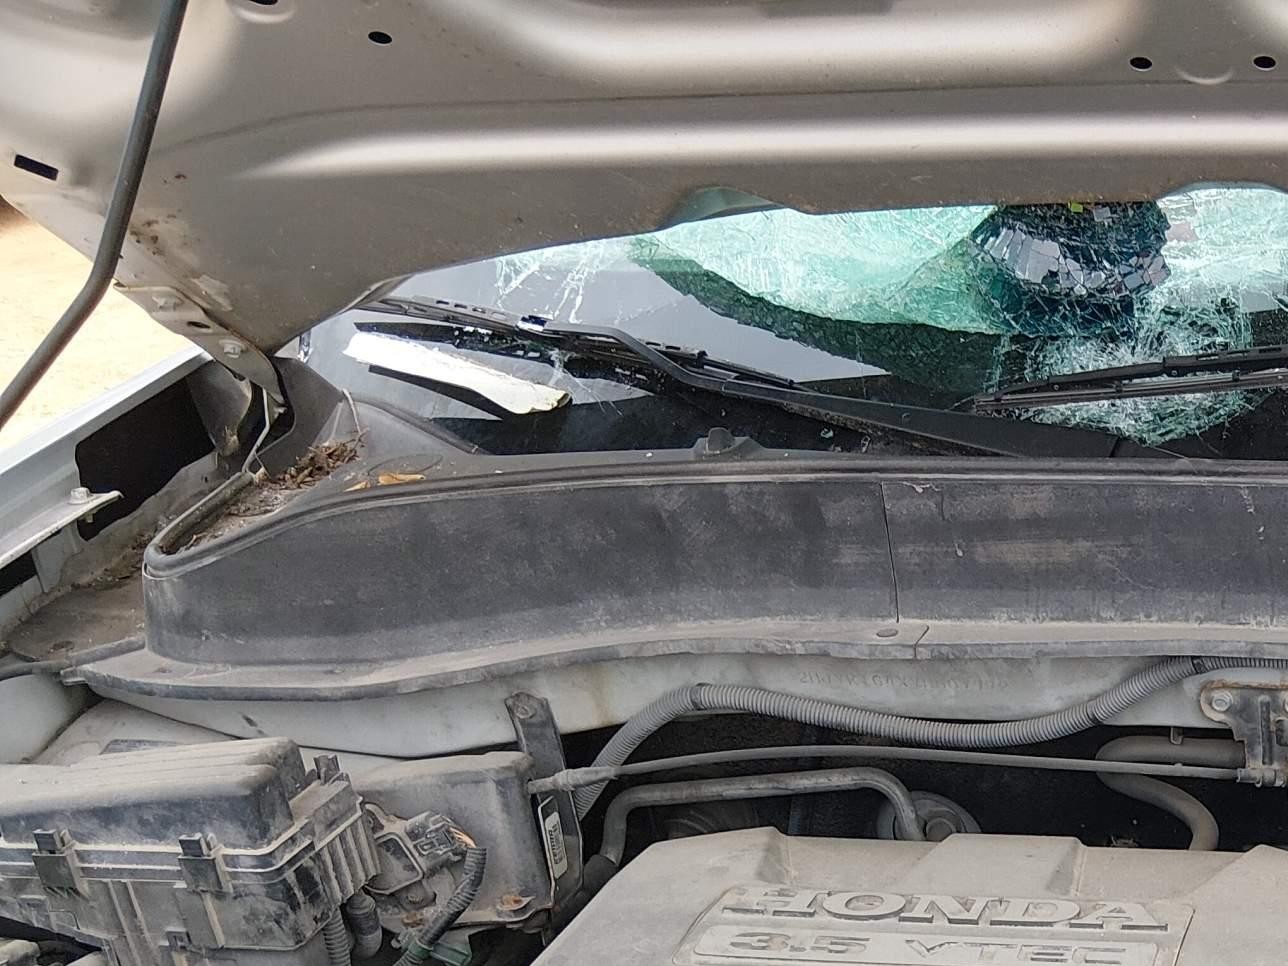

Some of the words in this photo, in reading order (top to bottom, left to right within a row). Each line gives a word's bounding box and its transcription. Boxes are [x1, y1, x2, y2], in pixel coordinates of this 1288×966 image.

[722, 889, 1169, 931] HONDA
[729, 932, 871, 954] 3.5
[904, 939, 1127, 965] VTEC
